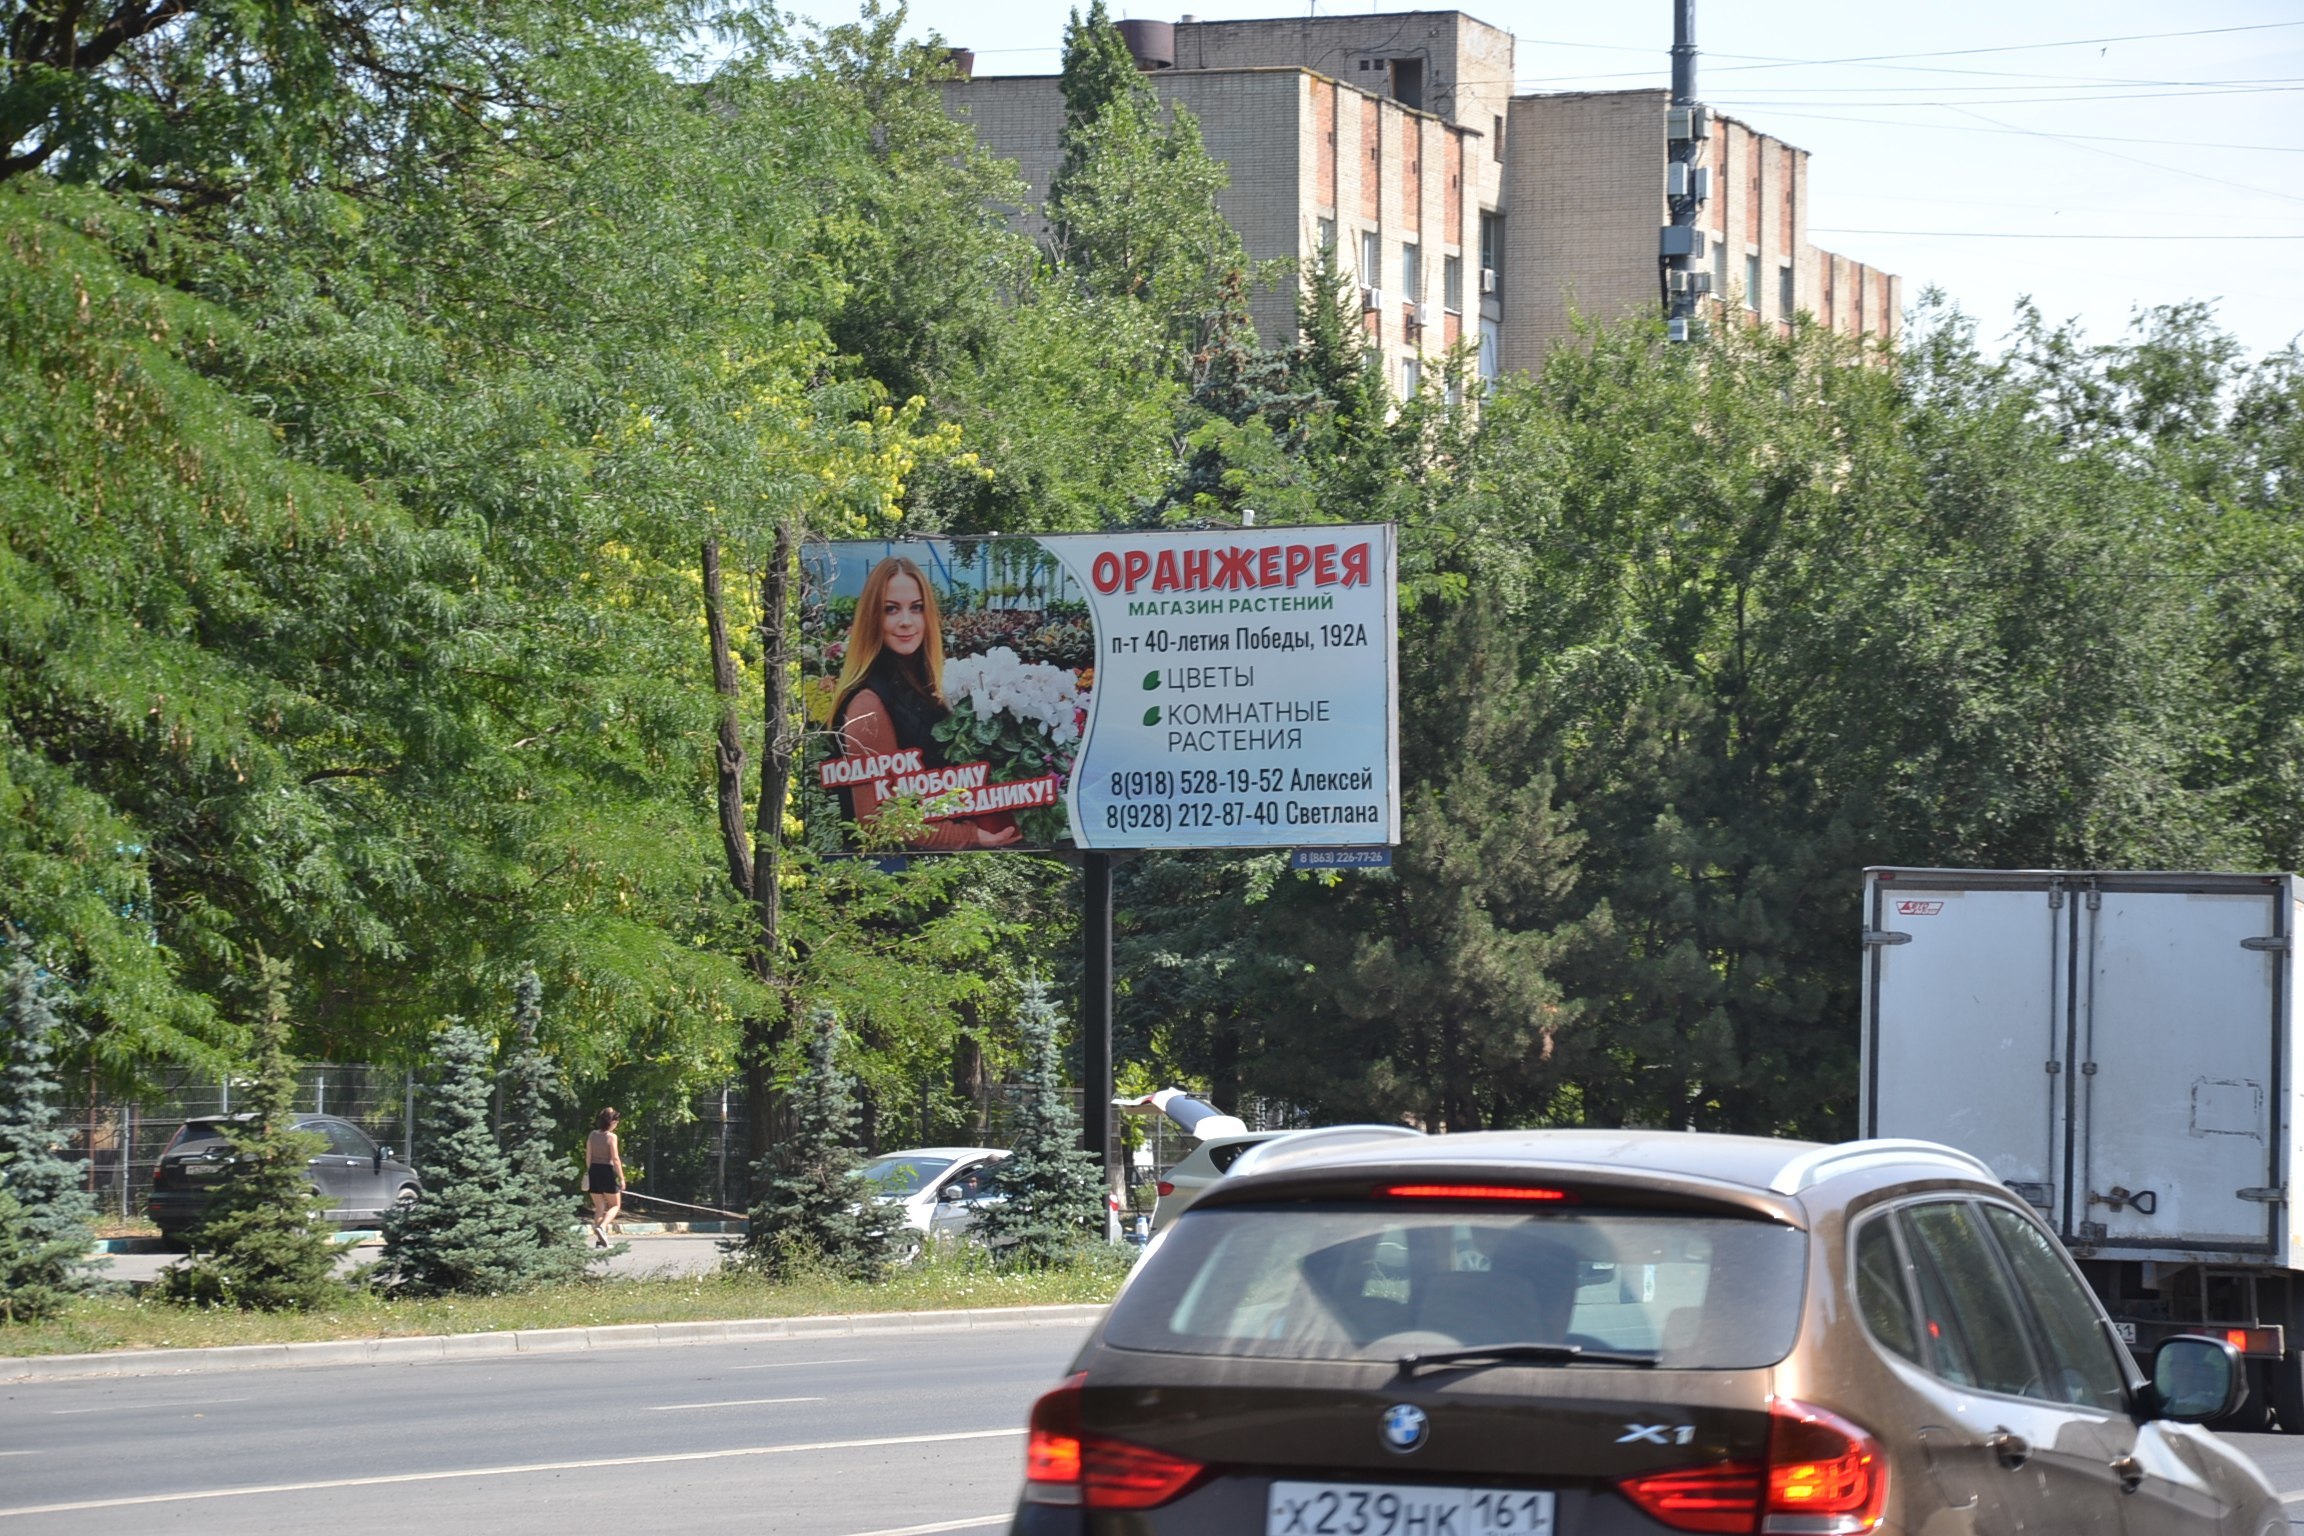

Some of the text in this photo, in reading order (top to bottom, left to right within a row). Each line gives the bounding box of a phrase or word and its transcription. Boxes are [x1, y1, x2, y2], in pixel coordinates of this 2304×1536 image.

[1091, 542, 1370, 595] ОРАНЖЕРЕЯ
[1128, 592, 1334, 617] МАГАЗИН РАСТЕНИЙ
[1112, 623, 1368, 654] п-т 40-летия Победы, 192А
[1168, 665, 1255, 693] ЦВЕТЫ
[1168, 700, 1330, 725] КОМНАТНЫЕ
[1168, 728, 1302, 752] РАСТЕНИЯ
[821, 750, 922, 785] ПОДАРОК
[875, 764, 987, 801] К ЛЮБОМУ
[1111, 766, 1373, 800] 8(918) 528-19-52 Алексей
[1107, 800, 1379, 833] 8(928) 212-87-40 Светлана
[1300, 851, 1383, 863] 8 (863) 226-77-26
[1614, 1423, 1697, 1446] X1
[1473, 1493, 1541, 1529] 161
